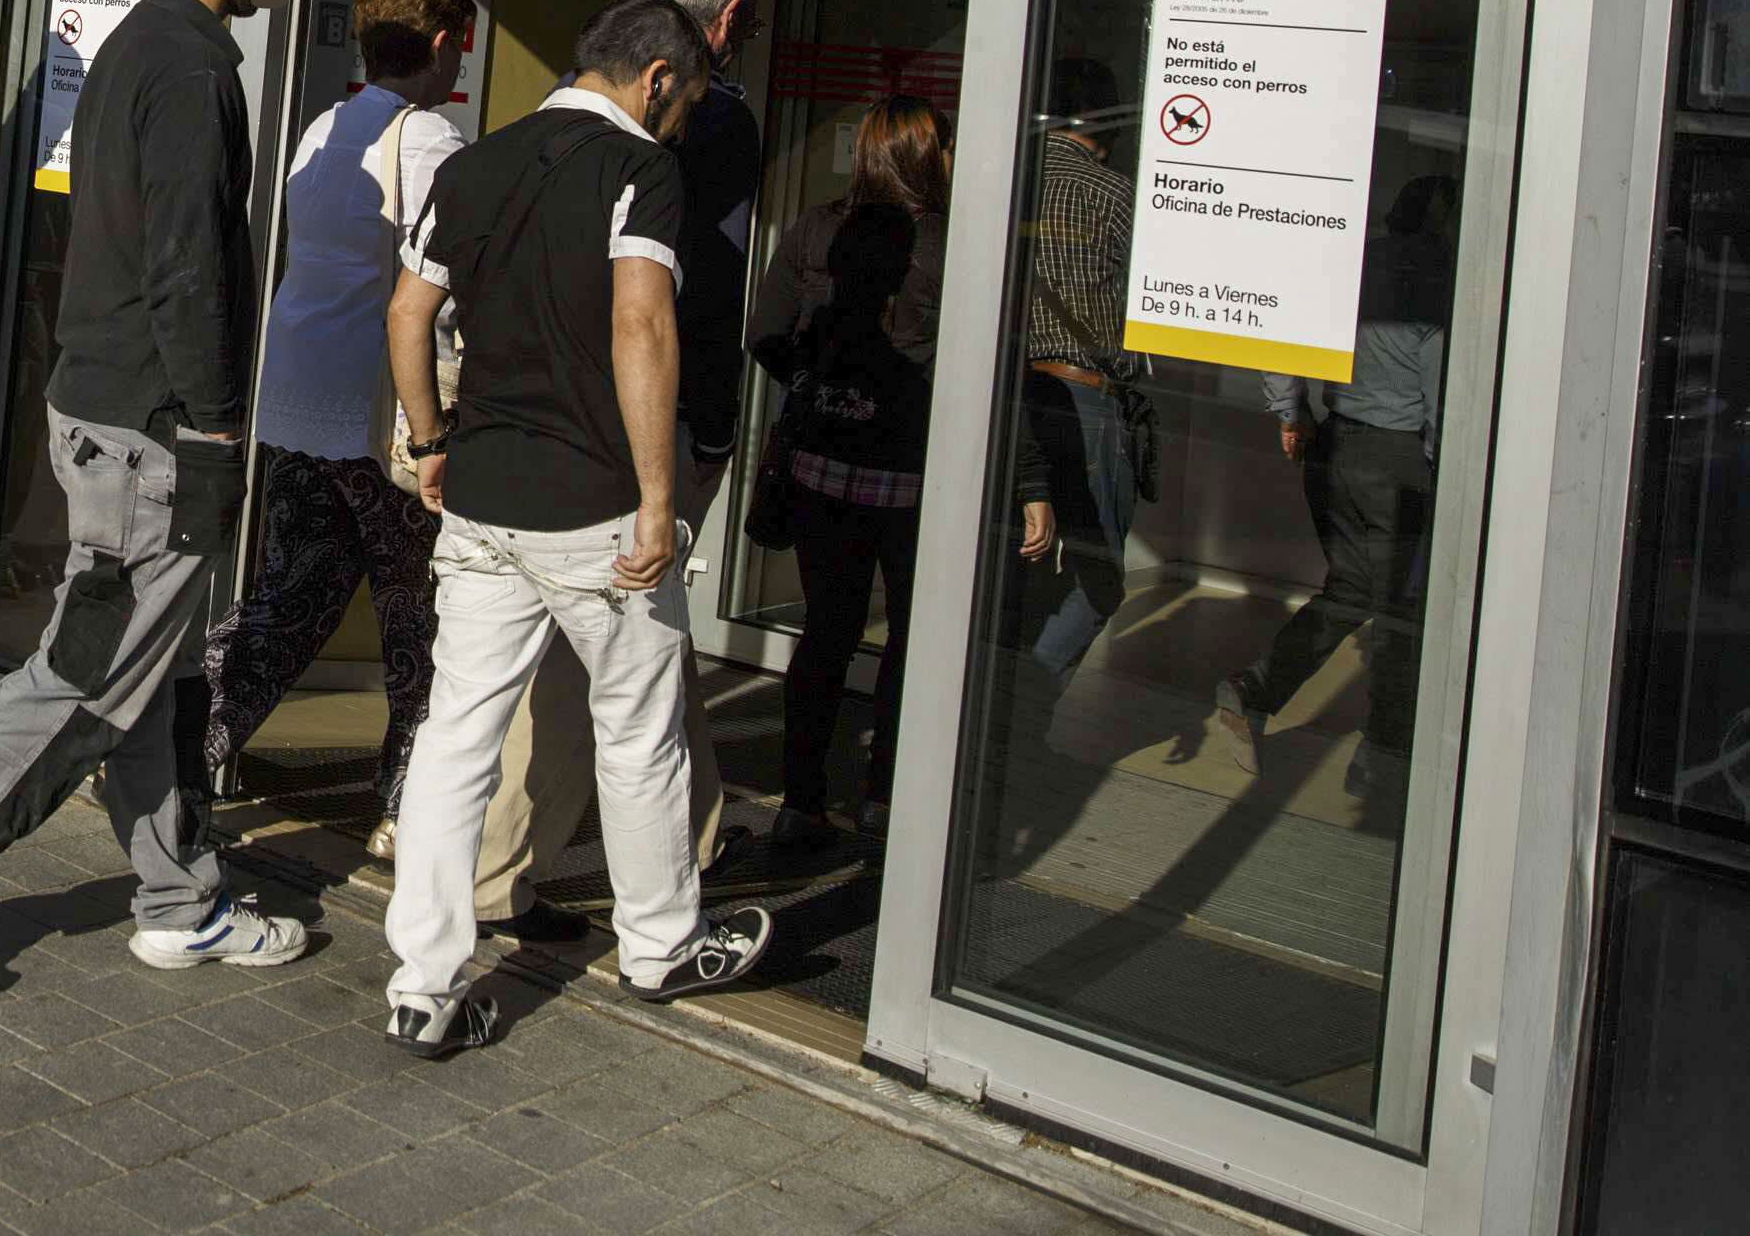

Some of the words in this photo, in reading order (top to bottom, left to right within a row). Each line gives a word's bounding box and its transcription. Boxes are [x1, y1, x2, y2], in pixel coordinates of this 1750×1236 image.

[1167, 38, 1187, 50] No
[1192, 40, 1224, 53] está
[52, 64, 87, 78] Horario
[1165, 56, 1237, 72] permitido
[1243, 60, 1256, 72] el
[51, 79, 79, 92] Oficina
[1164, 73, 1218, 87] acceso
[1223, 78, 1251, 90] con
[1256, 80, 1307, 94] perros
[46, 136, 71, 149] Lunes
[44, 151, 56, 162] De
[58, 153, 63, 164] 9
[1154, 173, 1224, 195] Horario
[1152, 193, 1207, 214] Oficina
[1213, 201, 1232, 217] de
[1238, 203, 1347, 230] Prestaciones
[1143, 275, 1195, 298] Lunes
[1199, 285, 1210, 300] a
[1214, 285, 1279, 309] Viernes
[1141, 295, 1165, 314] De
[1169, 299, 1181, 317] 9
[1185, 301, 1201, 320] h.
[1205, 307, 1216, 321] a
[1222, 307, 1242, 326] 14
[1247, 309, 1263, 329] h.
